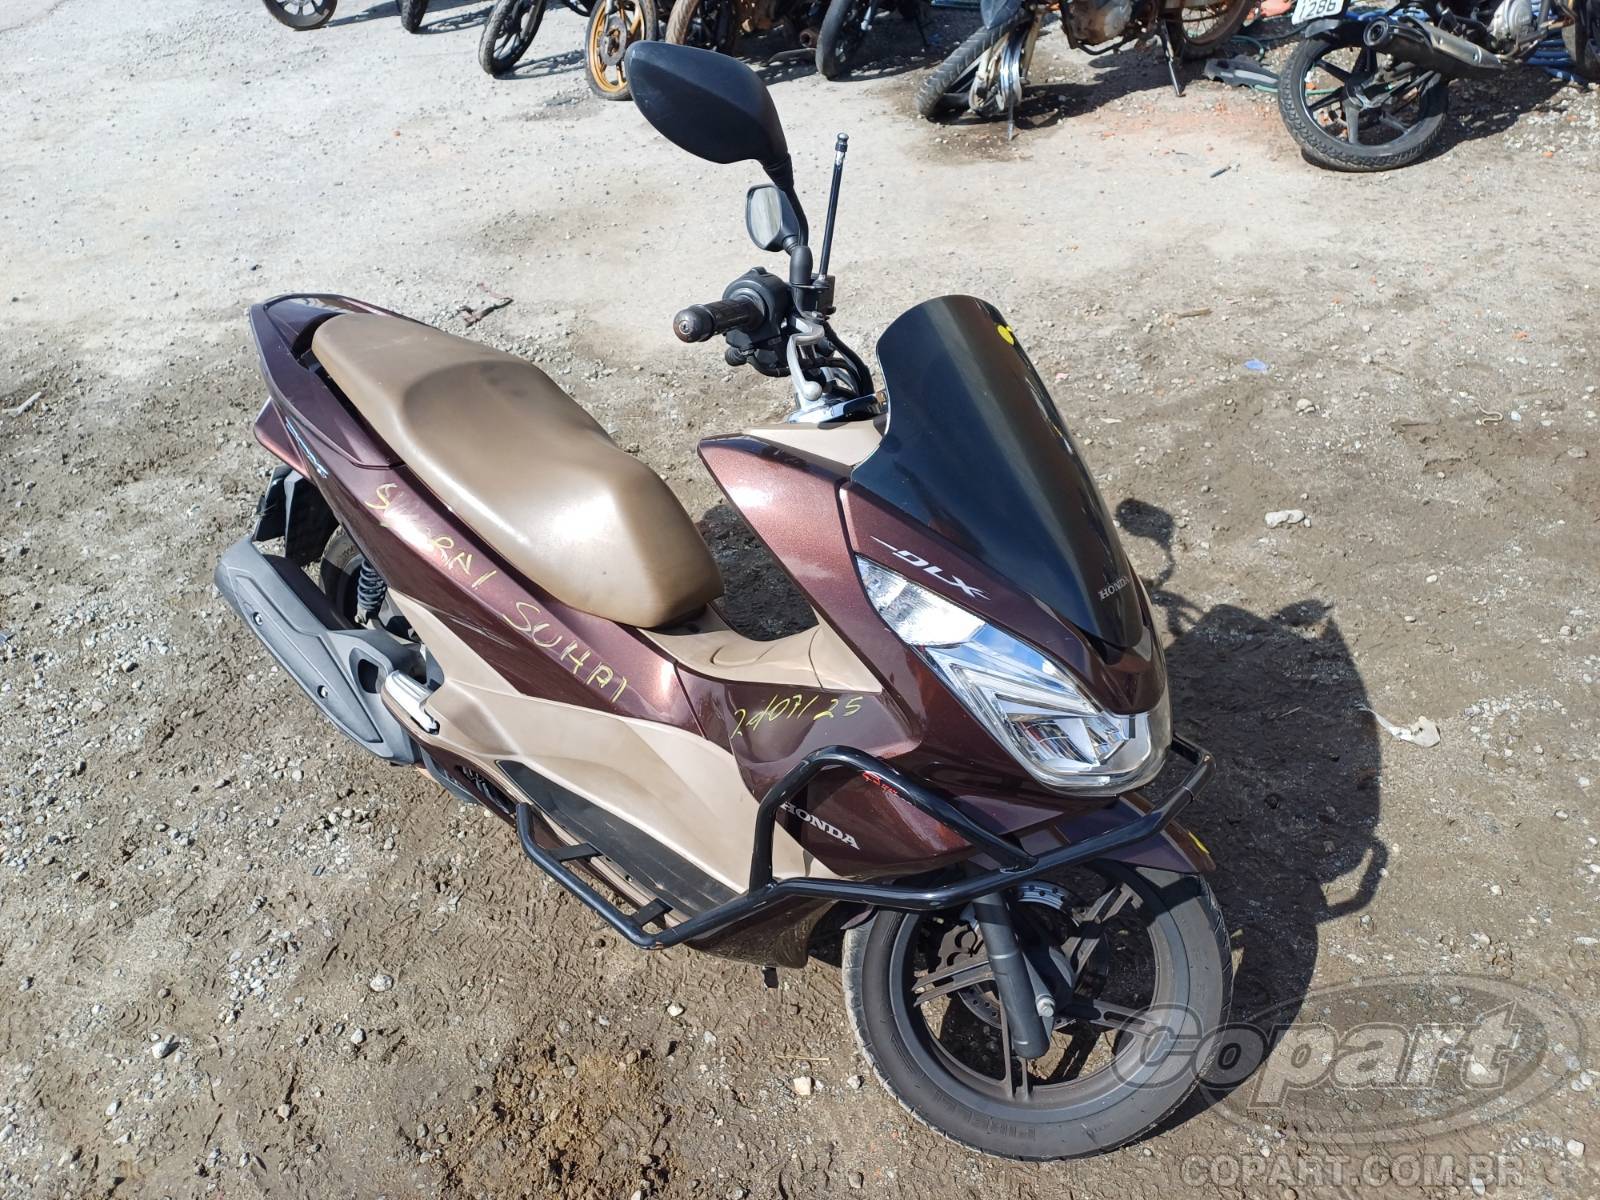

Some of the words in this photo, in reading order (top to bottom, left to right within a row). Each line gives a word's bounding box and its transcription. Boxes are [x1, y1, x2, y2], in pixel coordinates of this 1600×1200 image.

[890, 548, 991, 601] DLX
[1097, 575, 1131, 601] HONDA
[779, 801, 860, 850] HONDA
